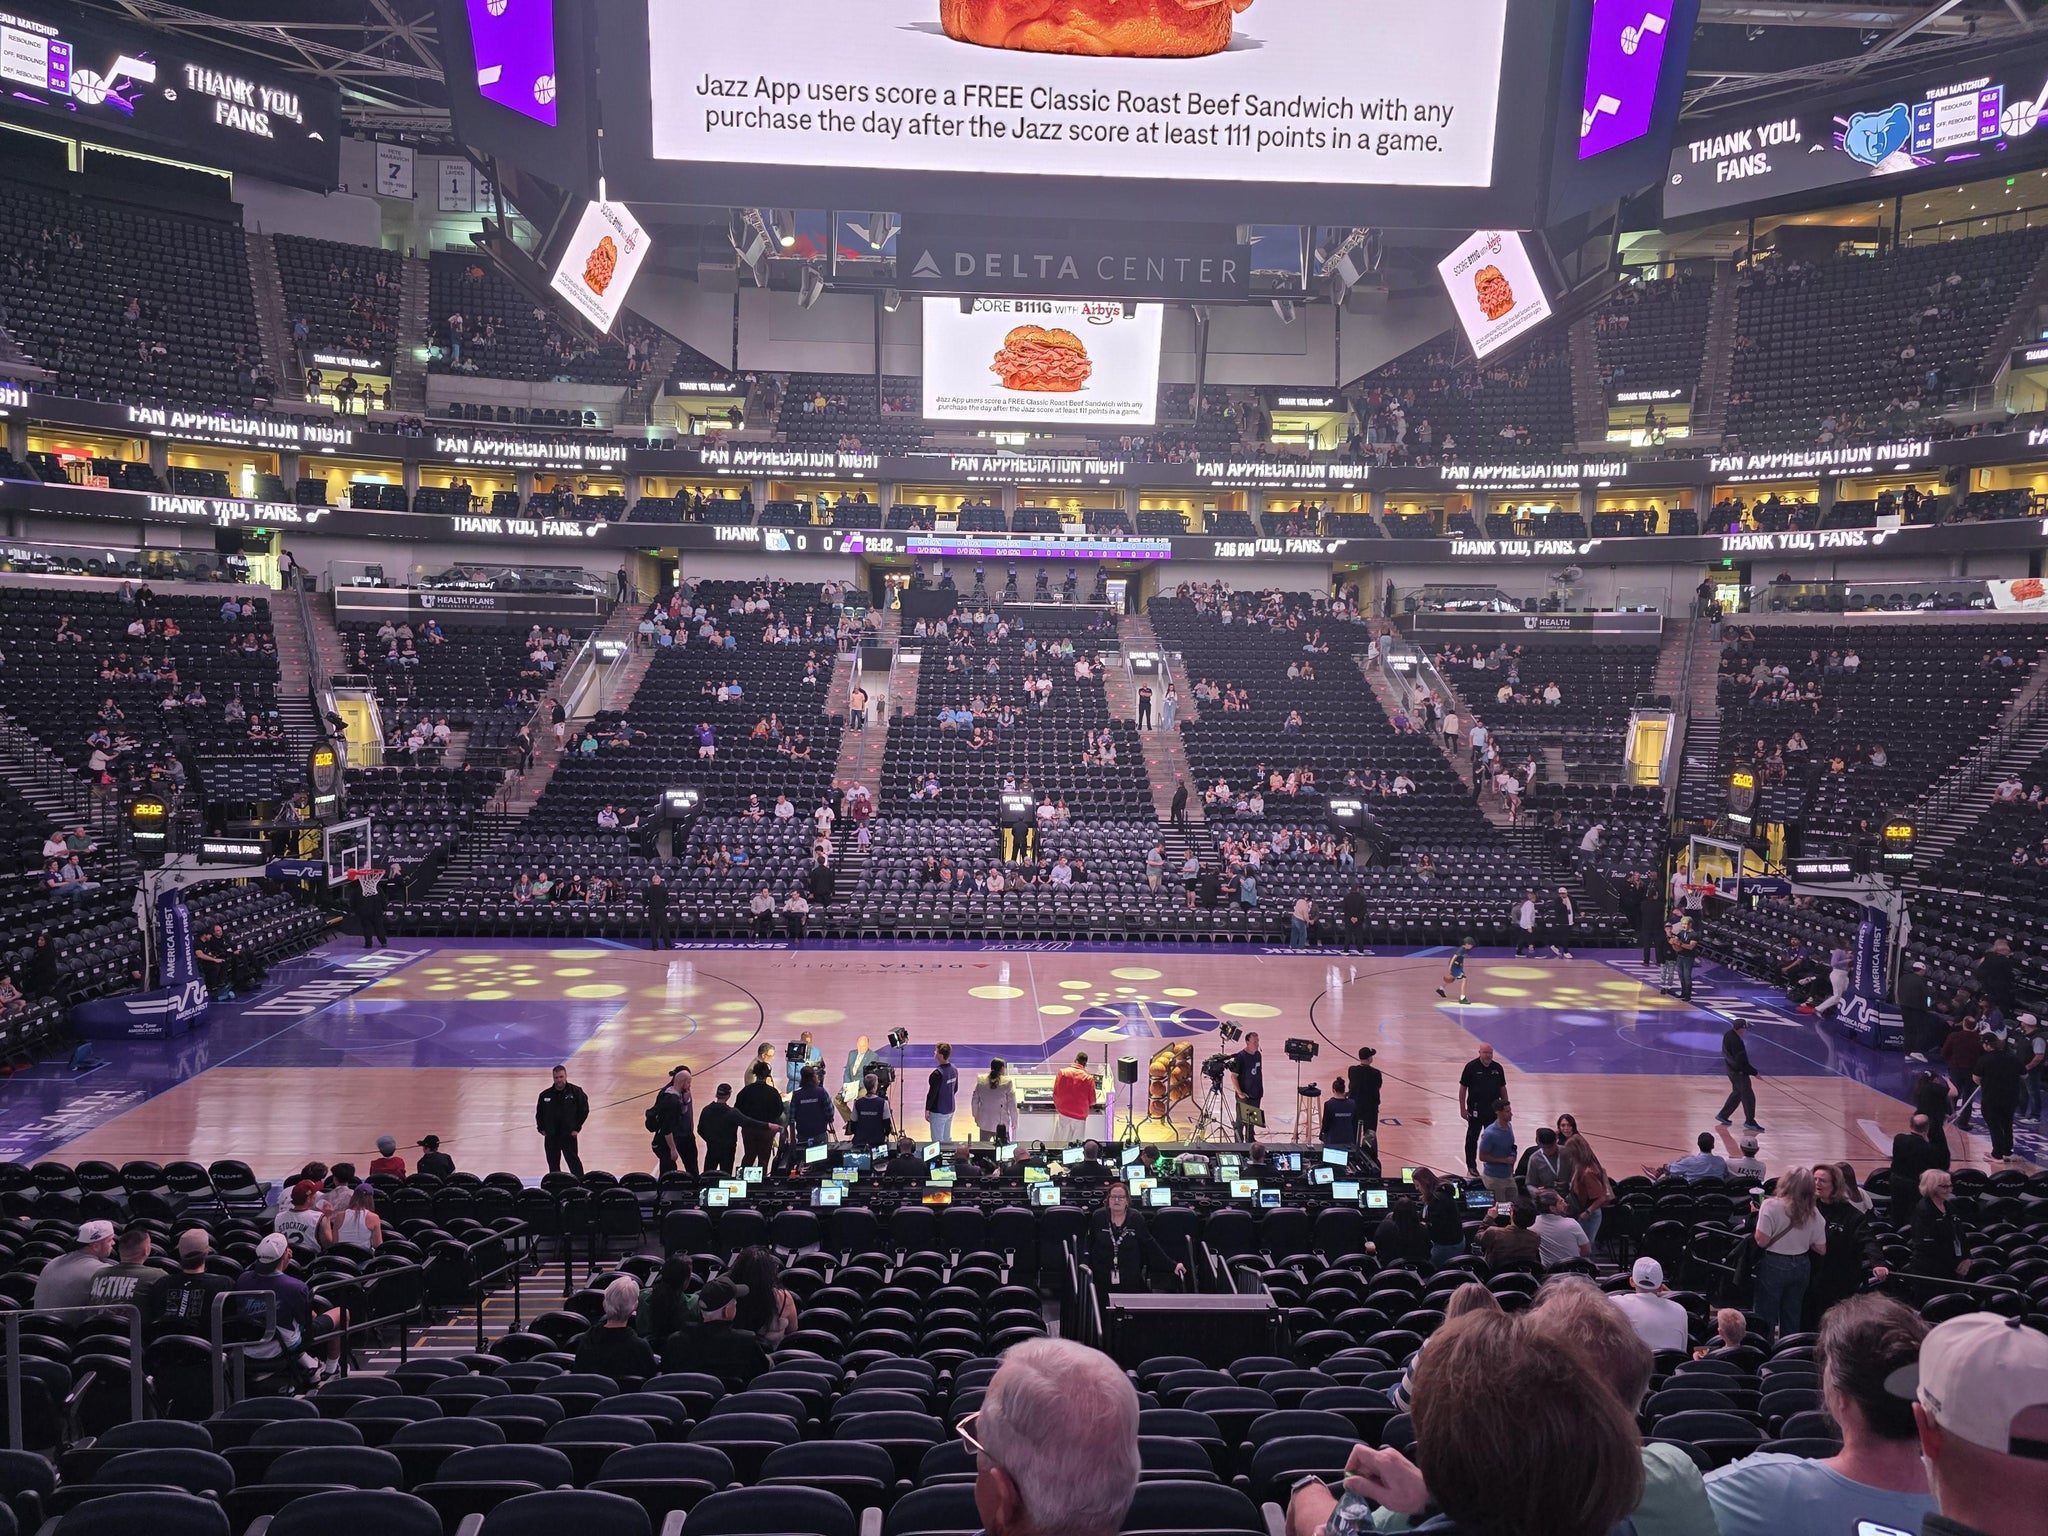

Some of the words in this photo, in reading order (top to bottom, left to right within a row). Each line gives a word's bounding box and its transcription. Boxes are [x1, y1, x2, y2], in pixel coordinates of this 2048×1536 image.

[8, 35, 42, 48] REBOUNDS
[16, 53, 46, 66] REBOUNDS
[16, 68, 46, 82] REBOUNDS
[184, 64, 254, 107] THANK
[260, 86, 302, 124] YOU,
[1926, 87, 1948, 100] TEAM
[1949, 78, 1990, 95] MATCHUP
[696, 74, 748, 97] Jazz
[754, 76, 800, 105] App
[808, 82, 869, 102] users
[875, 86, 937, 104] score
[944, 90, 956, 106] a
[964, 84, 1023, 108] FREE
[1030, 87, 1110, 112] Classic
[1118, 90, 1181, 114] Roast
[1188, 93, 1240, 116] Beef
[1245, 94, 1353, 120] Sandwich
[1360, 98, 1407, 121] with
[1414, 104, 1454, 128] any
[1941, 100, 1972, 112] REBOUNDS
[216, 100, 274, 138] FANS.
[1918, 107, 1932, 116] 42.1
[1948, 115, 1976, 126] REBOUNDS
[706, 105, 812, 132] purchase
[818, 108, 855, 132] the
[862, 110, 902, 140] day
[908, 113, 964, 136] after
[968, 114, 1006, 138] the
[1012, 117, 1062, 140] Jazz
[1069, 124, 1129, 142] score
[1136, 124, 1158, 144] at
[1165, 122, 1218, 146] least
[1224, 124, 1250, 146] 111
[1258, 126, 1326, 152] points
[1332, 127, 1350, 148] in
[1358, 134, 1370, 150] a
[1376, 134, 1442, 156] game.
[1918, 123, 1930, 132] 11.2
[1948, 131, 1975, 141] REBOUNDS
[1689, 128, 1752, 163] THANK
[1757, 118, 1800, 147] YOU,
[380, 153, 410, 162] MARAVICH
[389, 164, 400, 179] 7
[1716, 153, 1772, 183] FANS.
[452, 179, 458, 193] 1
[955, 253, 1079, 279] DELTA
[1098, 256, 1236, 283] CENTER
[974, 300, 1010, 312] CORE
[1015, 302, 1051, 313] B111G
[1054, 306, 1078, 314] WITH
[1081, 302, 1120, 318] Arby's
[314, 354, 336, 364] THANK
[352, 359, 369, 368] FANS.
[1026, 398, 1048, 406] Classic
[1085, 400, 1115, 408] Sandwich
[130, 406, 165, 426] FAN
[436, 438, 468, 454] FAN
[585, 446, 626, 462] NIGHT
[1710, 456, 1744, 472] FAN
[1877, 441, 1930, 460] NIGHT
[700, 450, 730, 464] FAN
[838, 454, 878, 469] NIGHT
[952, 457, 980, 472] FAN
[1085, 459, 1125, 475] NIGHT
[1196, 463, 1224, 477] FAN
[1329, 464, 1369, 480] NIGHT
[1441, 466, 1471, 480] FAN
[1582, 463, 1627, 478] NIGHT
[148, 496, 207, 515] THANK
[212, 500, 249, 520] YOU,
[254, 504, 302, 522] FANS.
[452, 516, 502, 534] THANK
[506, 518, 538, 538] YOU,
[542, 520, 582, 536] FANS.
[714, 526, 760, 542] THANK
[797, 536, 806, 550] 0
[824, 536, 832, 550] 0
[866, 538, 893, 552] 26:02
[1214, 542, 1237, 557] 7:06
[1239, 542, 1255, 556] PM
[1285, 538, 1324, 554] FANS.
[1450, 540, 1496, 555] THANK
[1500, 540, 1531, 557] YOU,
[1534, 540, 1576, 555] FANS.
[1721, 534, 1774, 550] THANK
[1778, 532, 1814, 551] YOU,
[1819, 530, 1868, 548] FANS.
[1733, 773, 1753, 788] 26:02
[136, 804, 162, 815] 26:02
[1886, 826, 1911, 836] 26:02
[204, 844, 226, 853] THANK
[228, 845, 242, 854] YOU,
[242, 846, 262, 854] FANS.
[1819, 864, 1832, 873] YOU,
[1832, 864, 1850, 872] FANS.
[164, 908, 174, 934] FIRST
[180, 908, 190, 933] FIRST
[184, 934, 192, 976] AMERICA
[674, 942, 788, 950] SEATGEEK
[167, 936, 176, 978] AMERICA
[1855, 950, 1864, 990] AMERICA
[1860, 924, 1868, 950] FIRST
[240, 980, 370, 1015] UTAH
[333, 949, 432, 978] JAZZ
[1872, 954, 1882, 994] AMERICA
[176, 1007, 195, 1020] AMERICA
[194, 1002, 208, 1013] FIRST
[1836, 1014, 1858, 1028] AMERICA
[1857, 1022, 1872, 1032] FIRST
[0, 1090, 126, 1141] HEALTH
[279, 1222, 308, 1232] STOCKTON
[91, 1276, 139, 1298] ACTIVE
